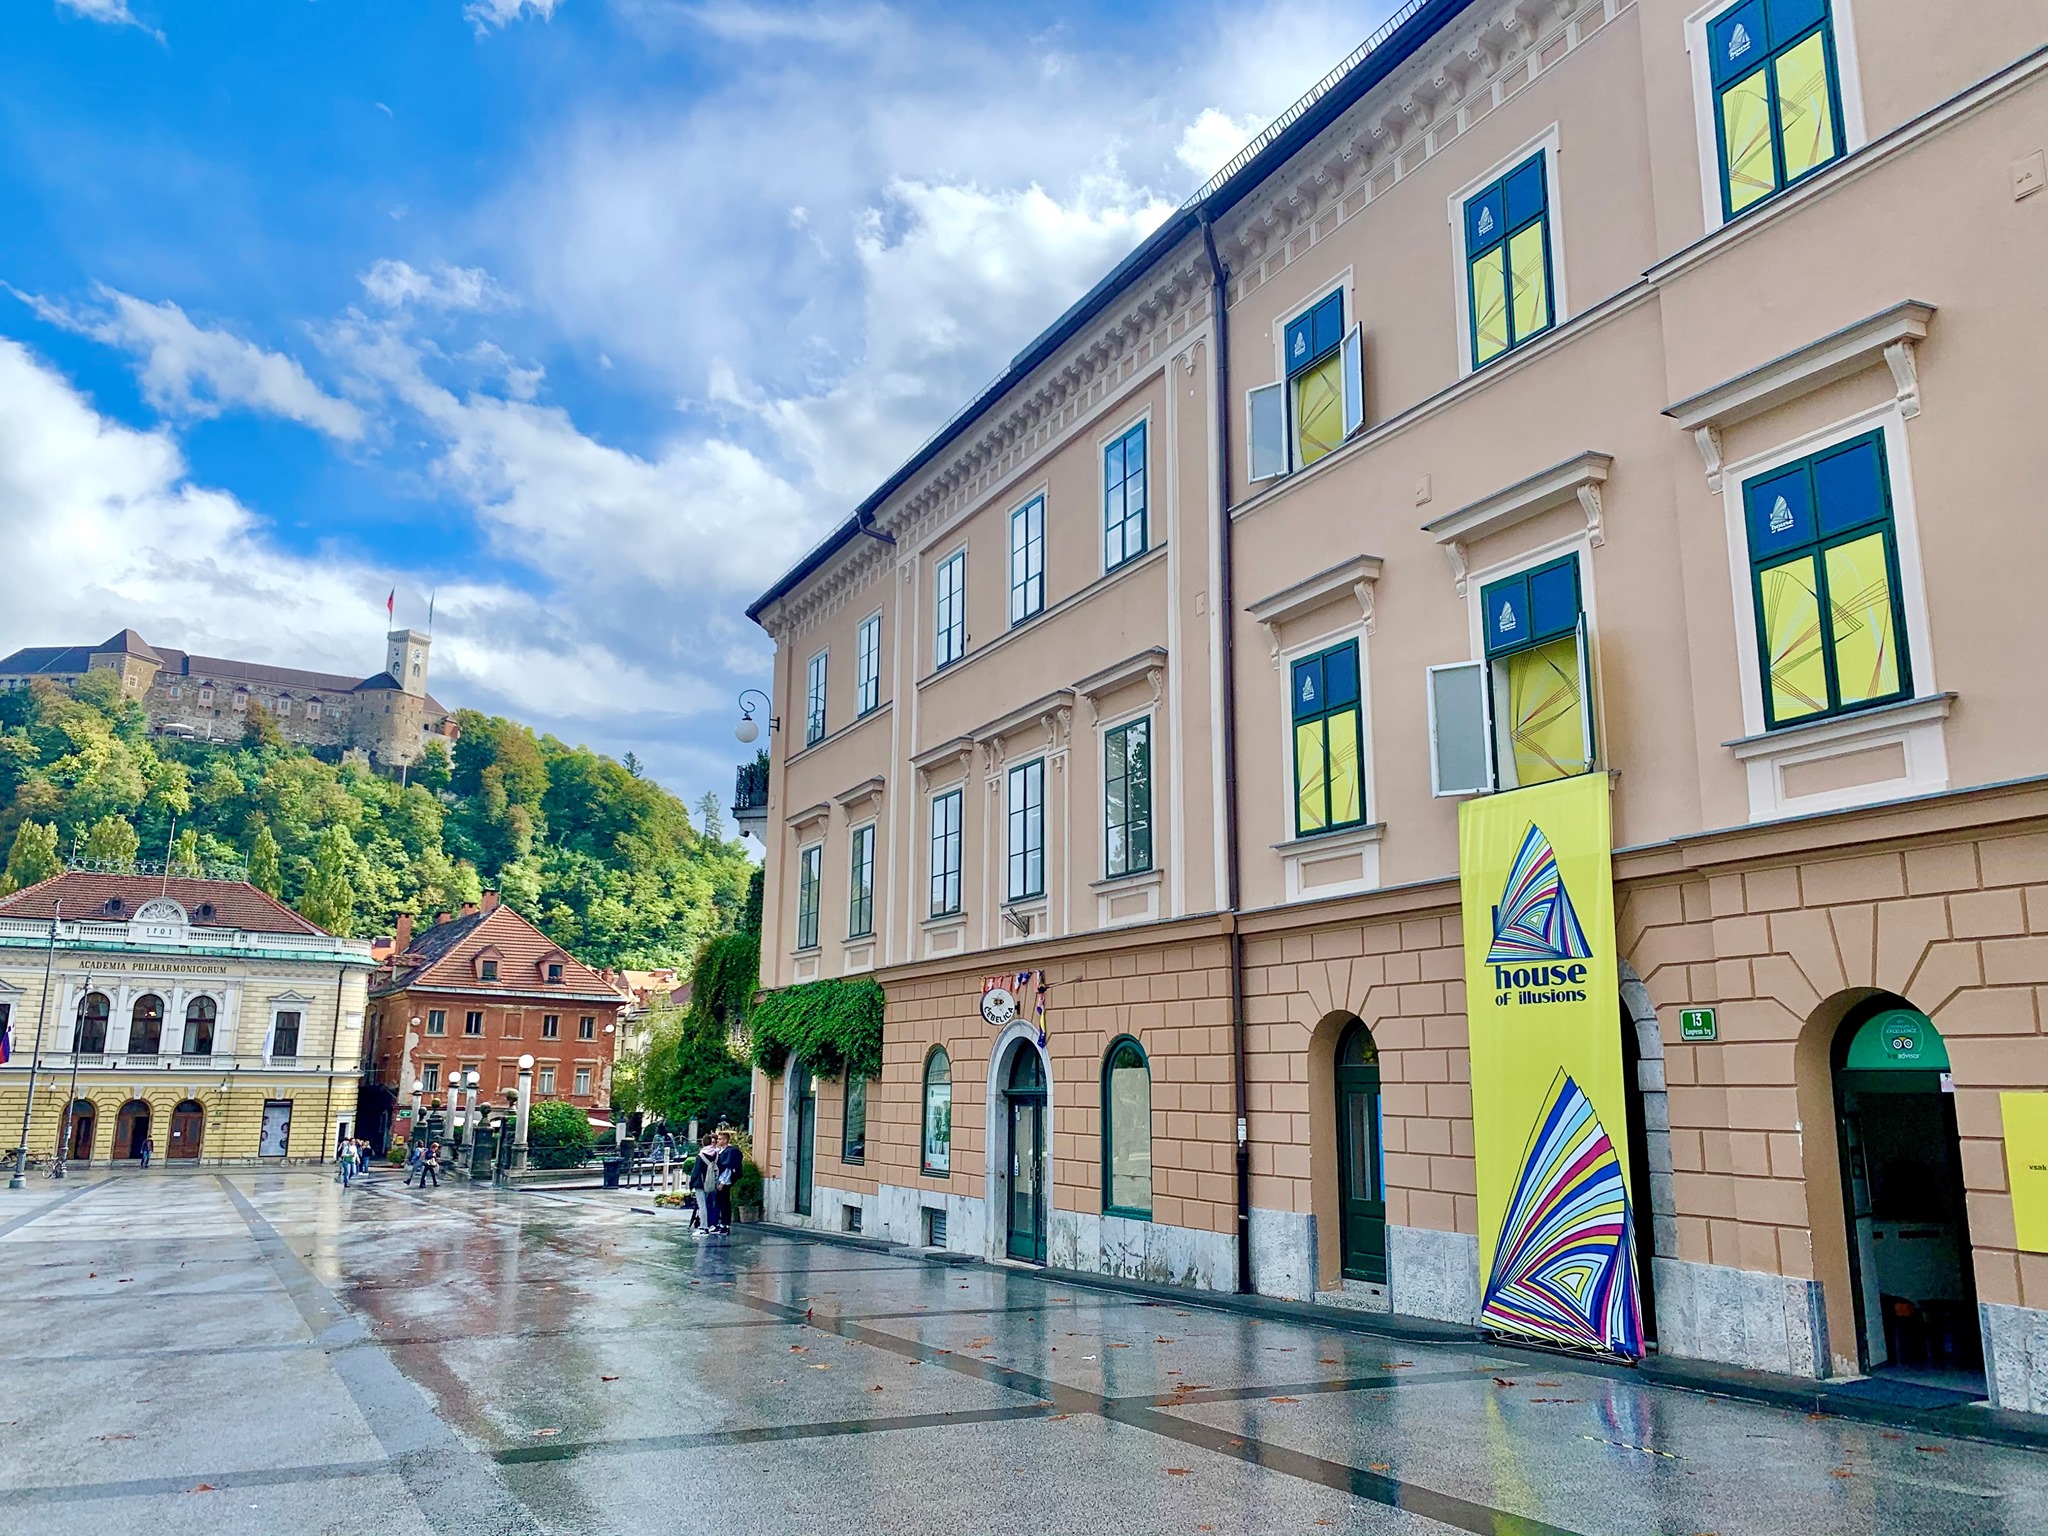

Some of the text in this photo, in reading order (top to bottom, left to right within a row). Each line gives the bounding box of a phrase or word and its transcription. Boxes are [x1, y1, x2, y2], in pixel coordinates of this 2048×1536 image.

[79, 960, 228, 974] ACADEMIA PHILHARMONICORUM
[1495, 963, 1587, 989] house
[1495, 989, 1587, 1006] of illusions
[1691, 1013, 1702, 1026] 13
